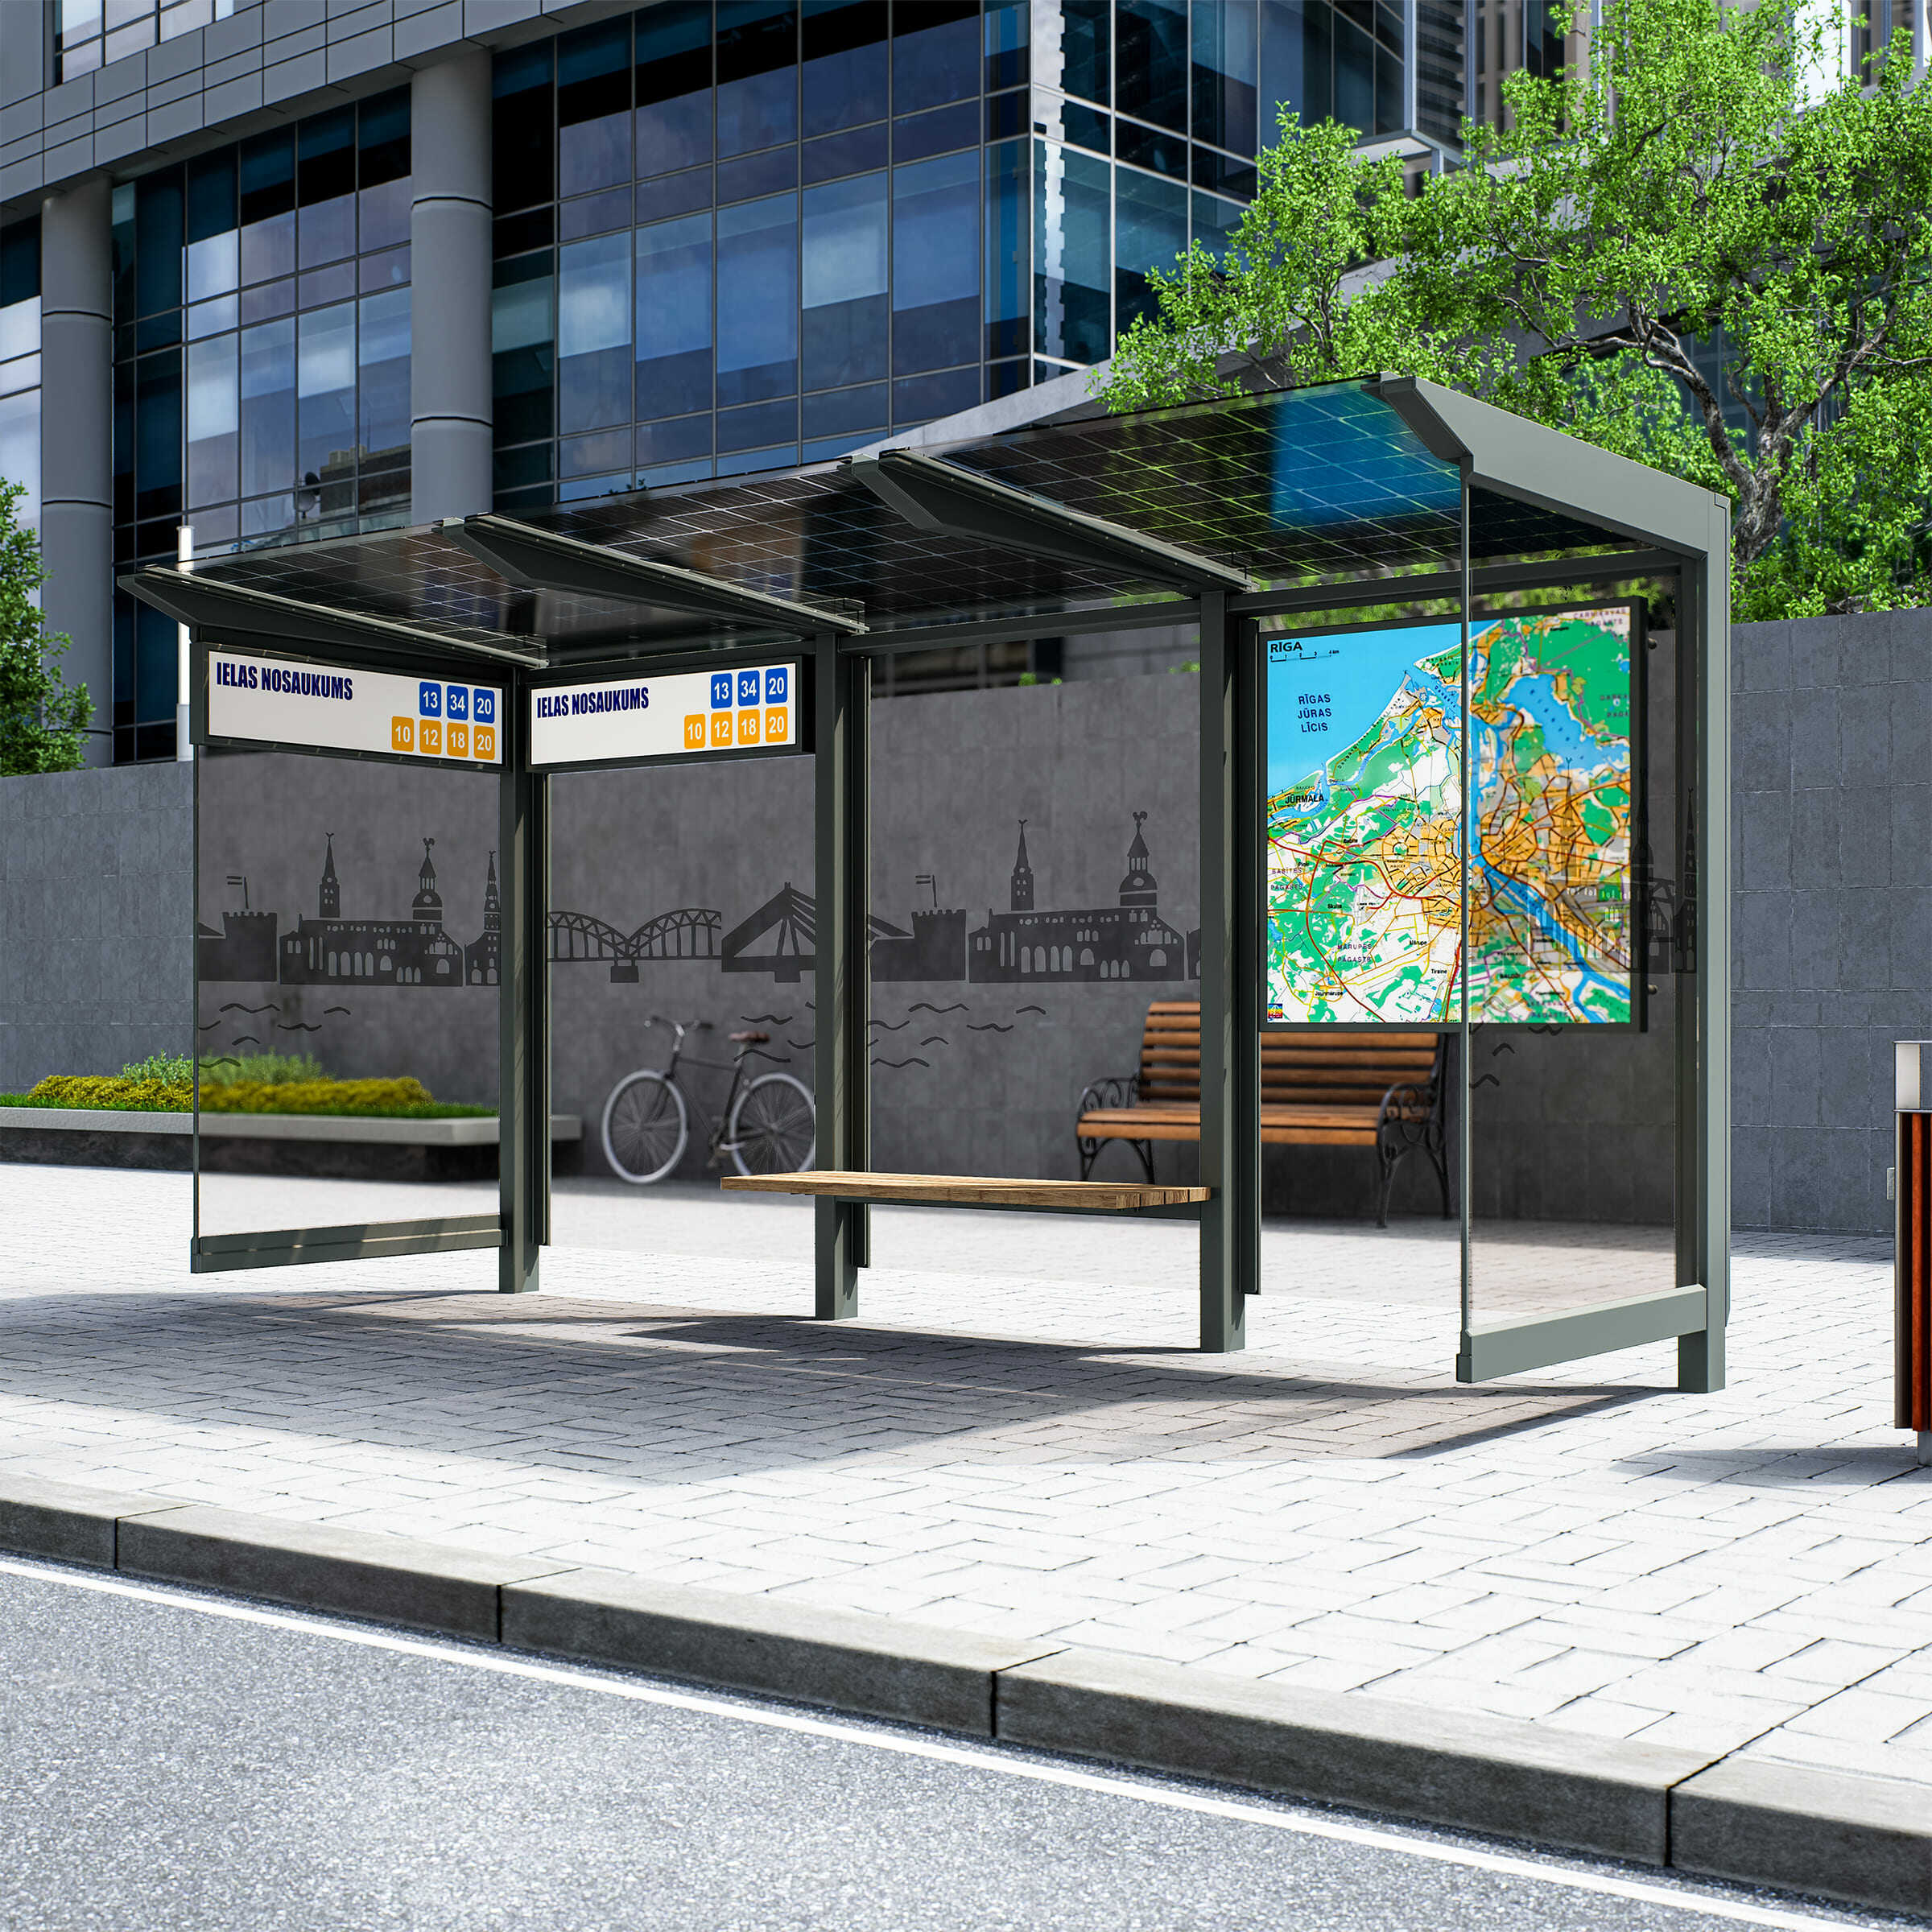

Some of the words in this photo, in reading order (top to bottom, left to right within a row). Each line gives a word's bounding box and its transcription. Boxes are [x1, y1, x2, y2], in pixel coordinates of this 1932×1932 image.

[1270, 641, 1302, 653] RĪGA
[217, 663, 258, 689] IELAS
[261, 667, 353, 700] NOSAUKUMS
[715, 683, 729, 700] 13
[741, 679, 756, 697] 34
[769, 677, 784, 695] 20
[423, 691, 437, 708] 13
[451, 695, 464, 711] 34
[477, 698, 491, 714] 20
[538, 695, 569, 718] IELAS
[572, 687, 649, 715] NOSAUKUMS
[1298, 693, 1331, 704] RĪGAS
[1298, 708, 1331, 719] JŪRAS
[396, 726, 410, 742] 10
[424, 729, 438, 745] 12
[451, 733, 464, 748] 18
[477, 734, 491, 751] 20
[688, 724, 702, 739] 10
[715, 721, 729, 737] 12
[742, 719, 756, 735] 18
[770, 716, 784, 733] 20
[1301, 721, 1328, 733] LĪCIS
